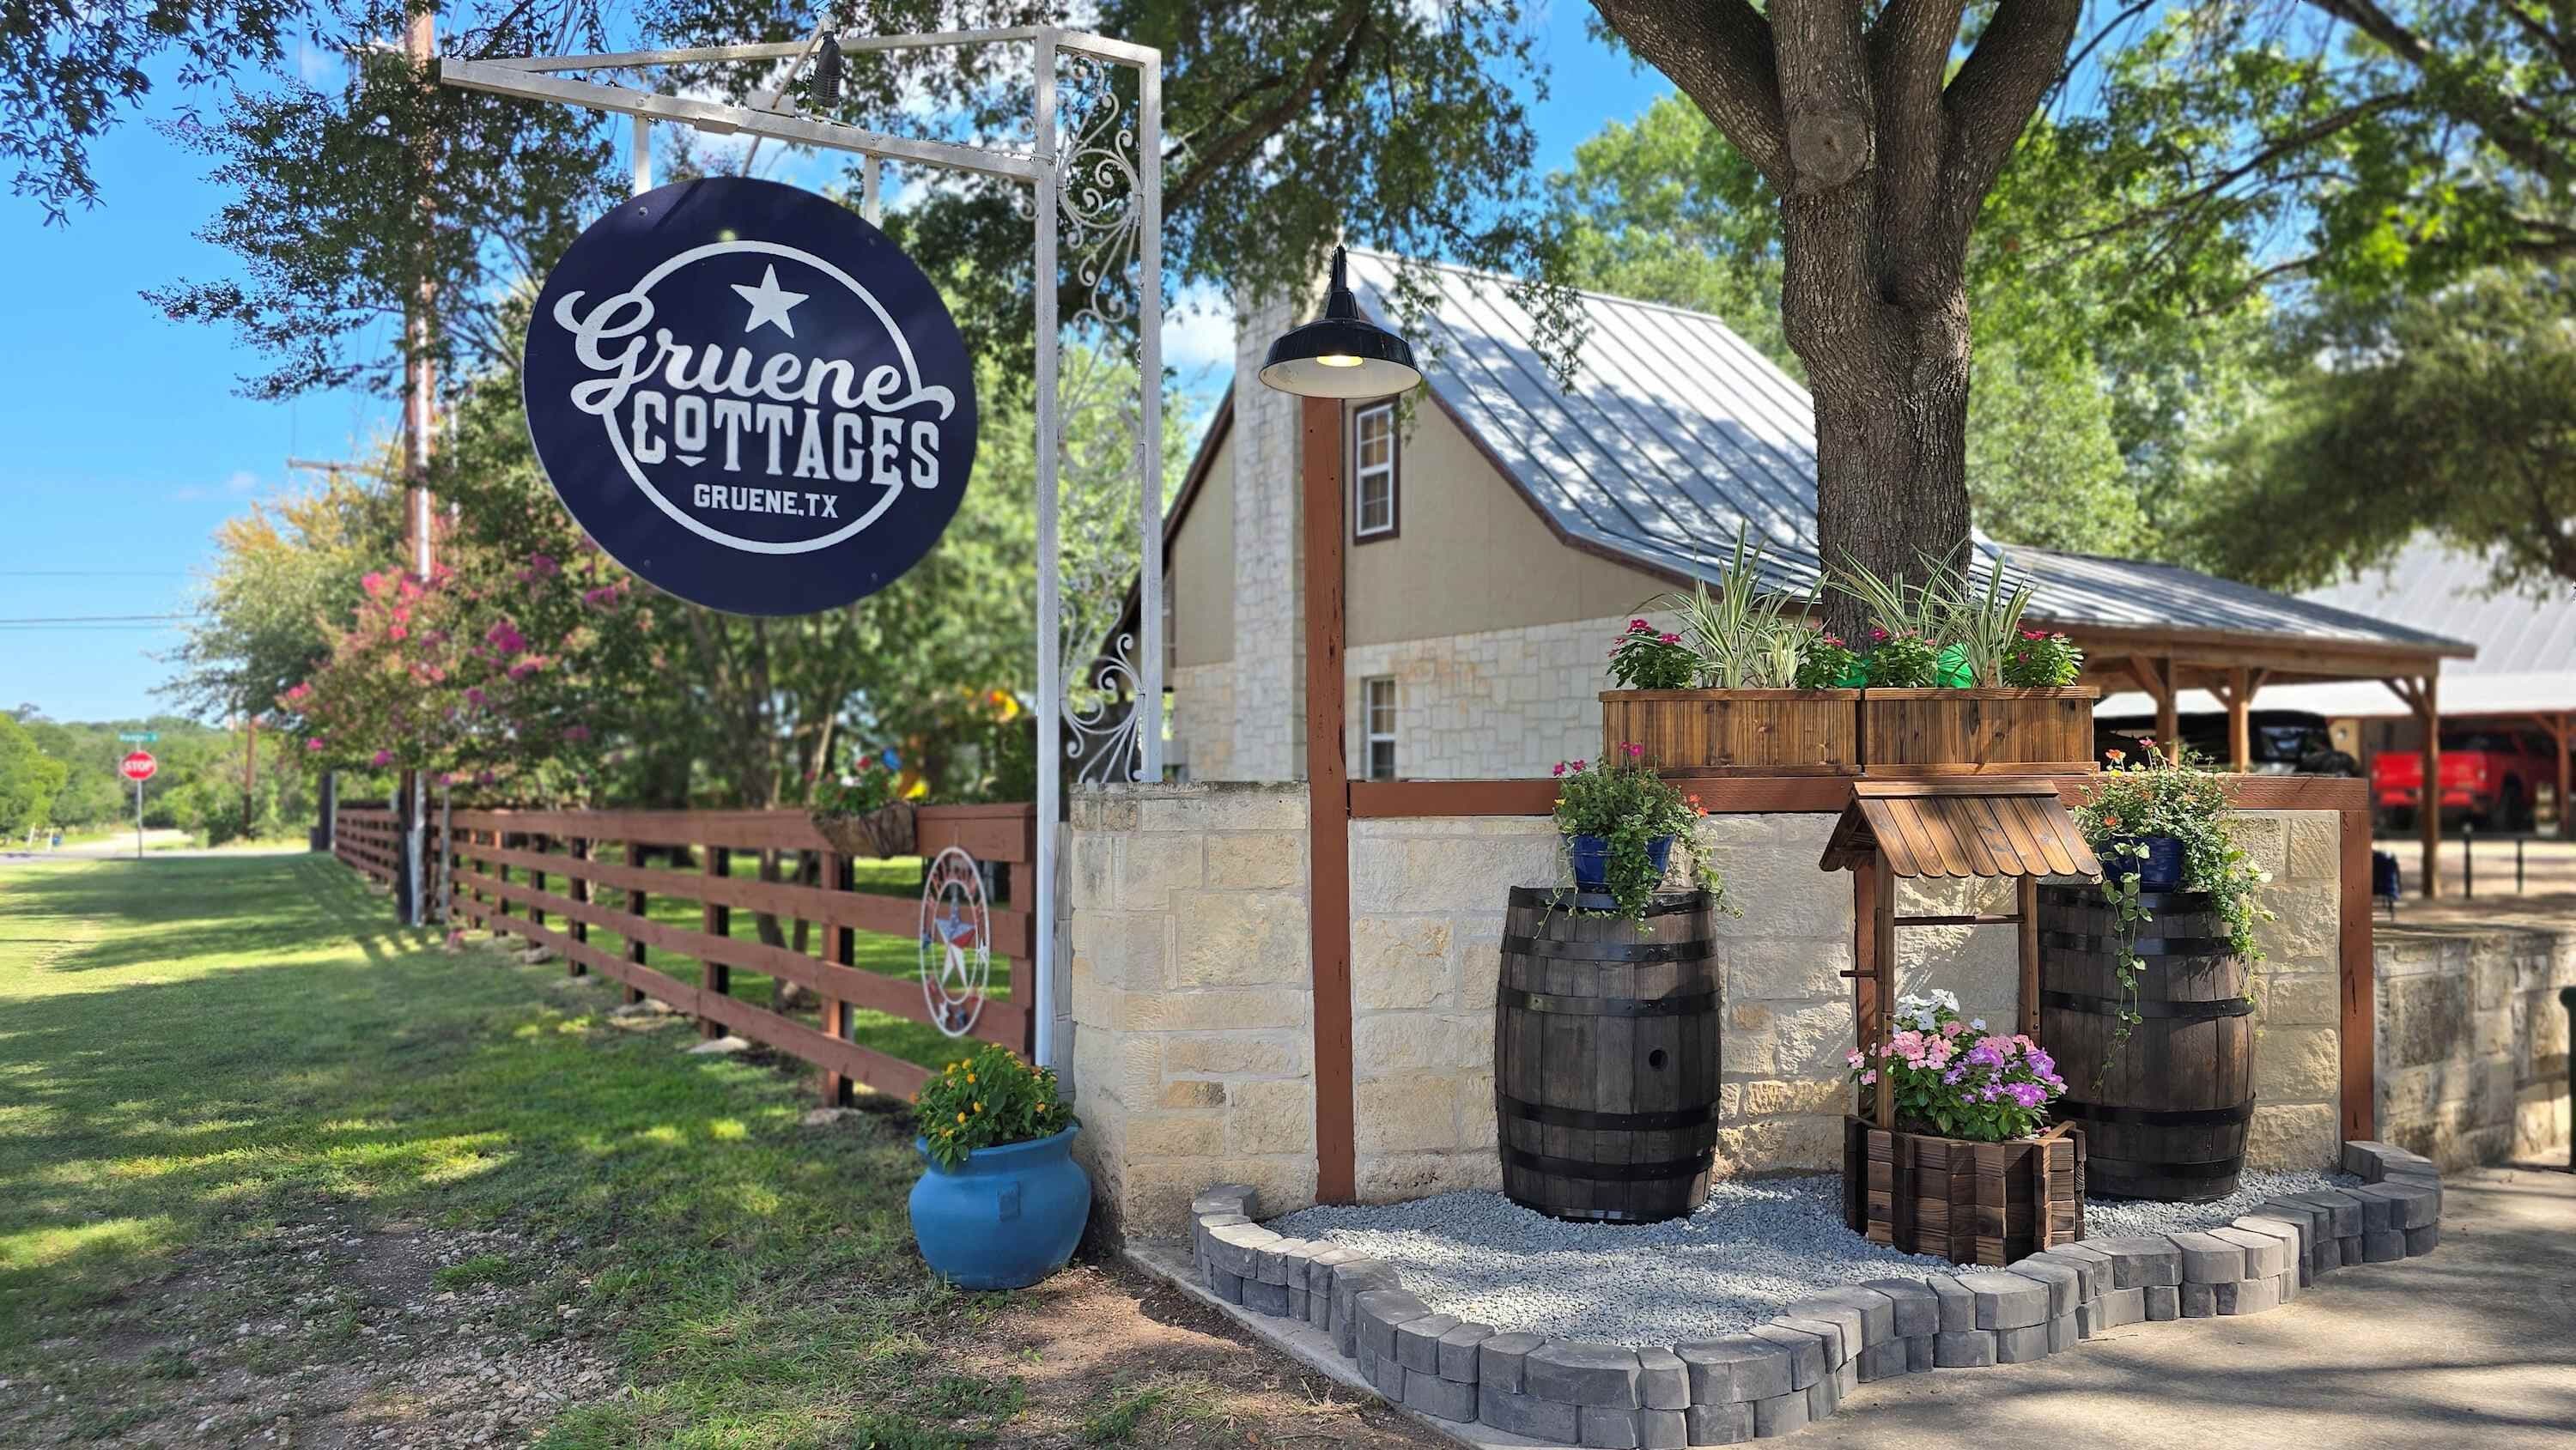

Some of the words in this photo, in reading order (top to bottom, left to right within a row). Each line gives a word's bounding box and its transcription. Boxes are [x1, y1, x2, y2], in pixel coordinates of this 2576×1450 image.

[553, 290, 955, 420] Gruene
[632, 390, 939, 489] COTTAGES
[125, 760, 154, 772] STOP
